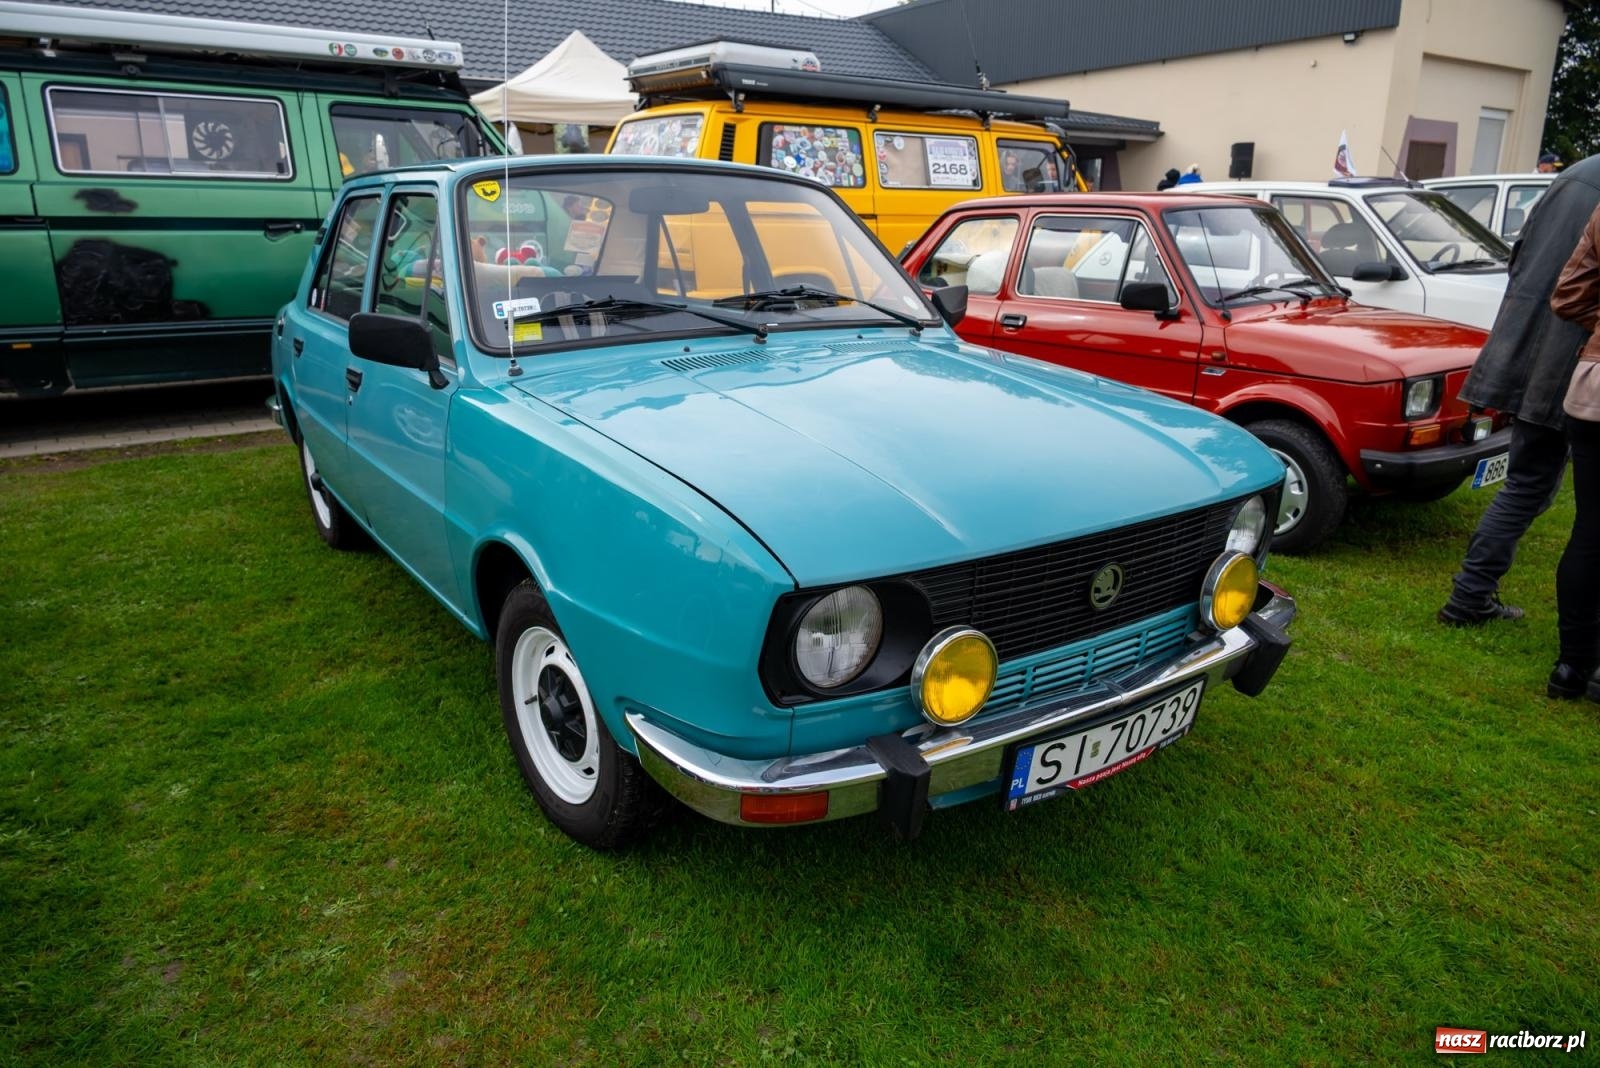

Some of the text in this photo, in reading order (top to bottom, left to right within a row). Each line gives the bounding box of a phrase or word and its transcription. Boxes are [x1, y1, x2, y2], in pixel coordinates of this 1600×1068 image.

[932, 162, 968, 175] 2168
[1036, 687, 1198, 785] SI 70739
[1010, 777, 1025, 791] PL
